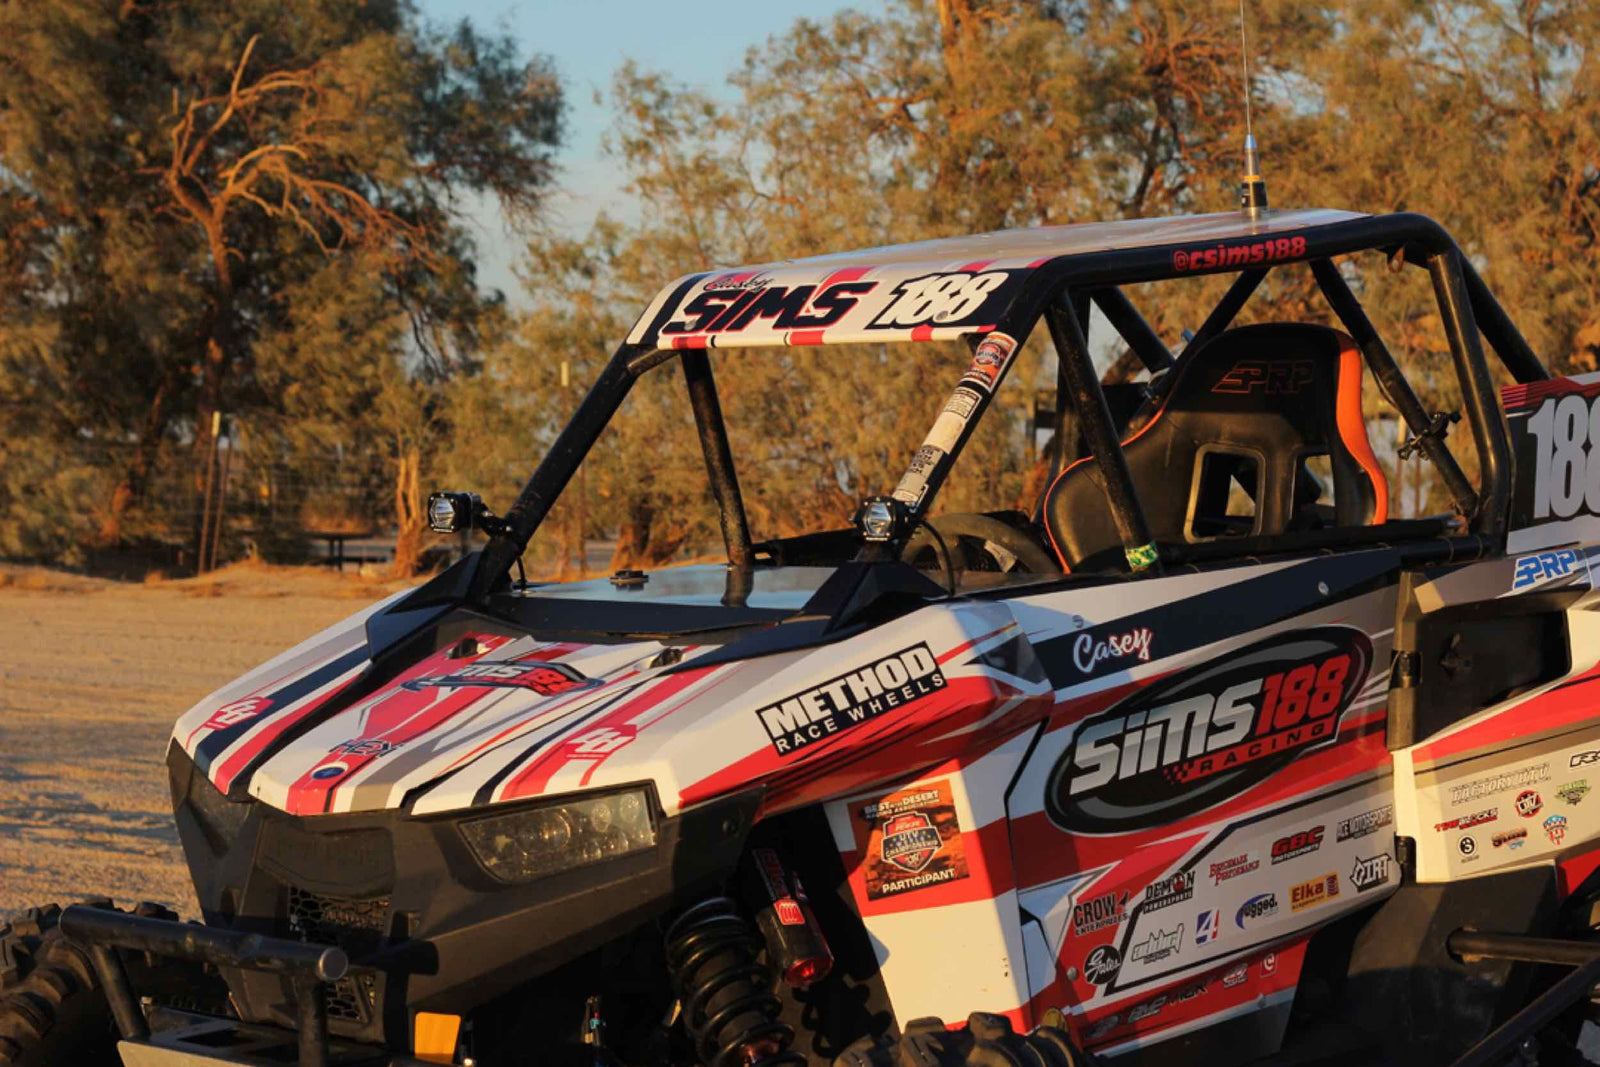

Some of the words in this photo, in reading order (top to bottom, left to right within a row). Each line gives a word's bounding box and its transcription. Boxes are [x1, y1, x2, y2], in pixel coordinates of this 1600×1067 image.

[1174, 236, 1306, 272] @csims188
[662, 281, 879, 335] SIMS
[868, 271, 1010, 327] 188
[1073, 628, 1153, 673] Casey
[759, 646, 937, 738] METHOD
[774, 717, 838, 754] RACE
[847, 672, 945, 723] WHEELS
[1200, 723, 1325, 773] RACING
[902, 789, 939, 806] DESERT
[1271, 825, 1325, 857] GBC
[882, 868, 956, 894] PARTICIPANT
[1292, 880, 1324, 904] Elka
[1074, 893, 1116, 927] CROW
